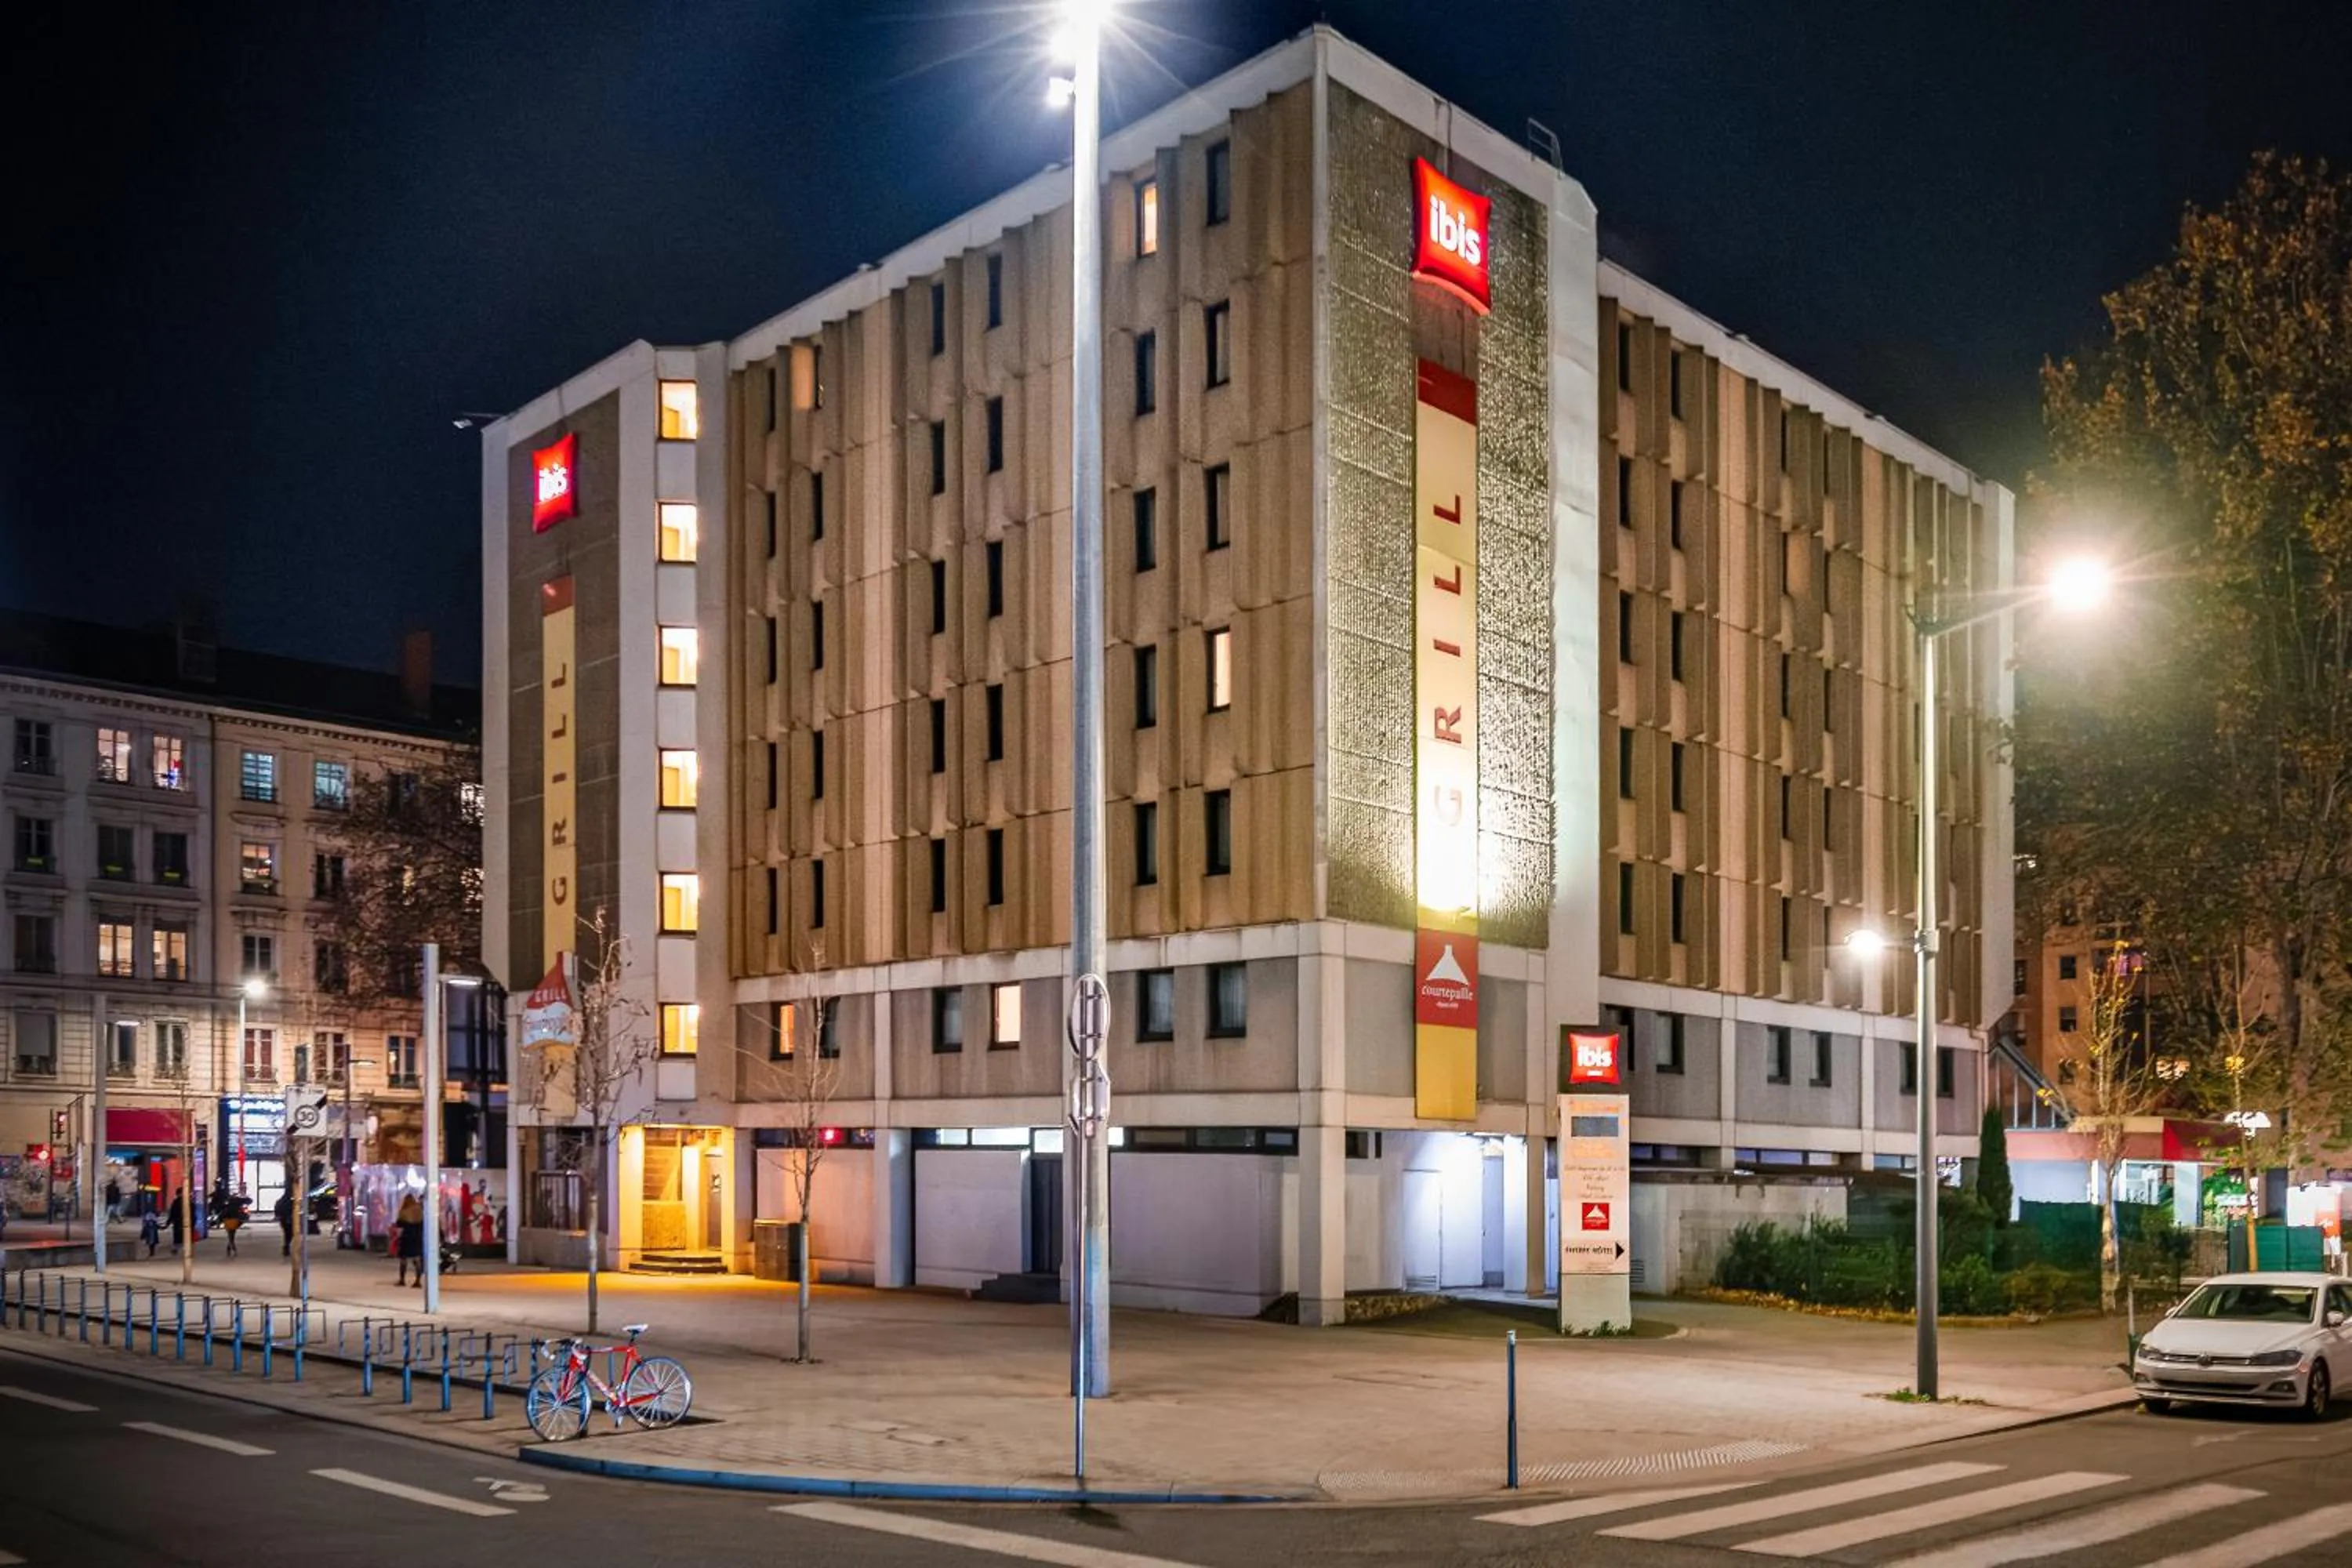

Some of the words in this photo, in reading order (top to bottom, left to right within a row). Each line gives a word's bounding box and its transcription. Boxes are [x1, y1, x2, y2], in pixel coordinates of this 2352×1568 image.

[1429, 194, 1482, 267] ibis
[539, 462, 568, 502] ibis
[1432, 494, 1462, 827] GRILL
[551, 663, 567, 906] GRILL
[1577, 1045, 1613, 1067] ibis
[299, 1110, 314, 1122] 30
